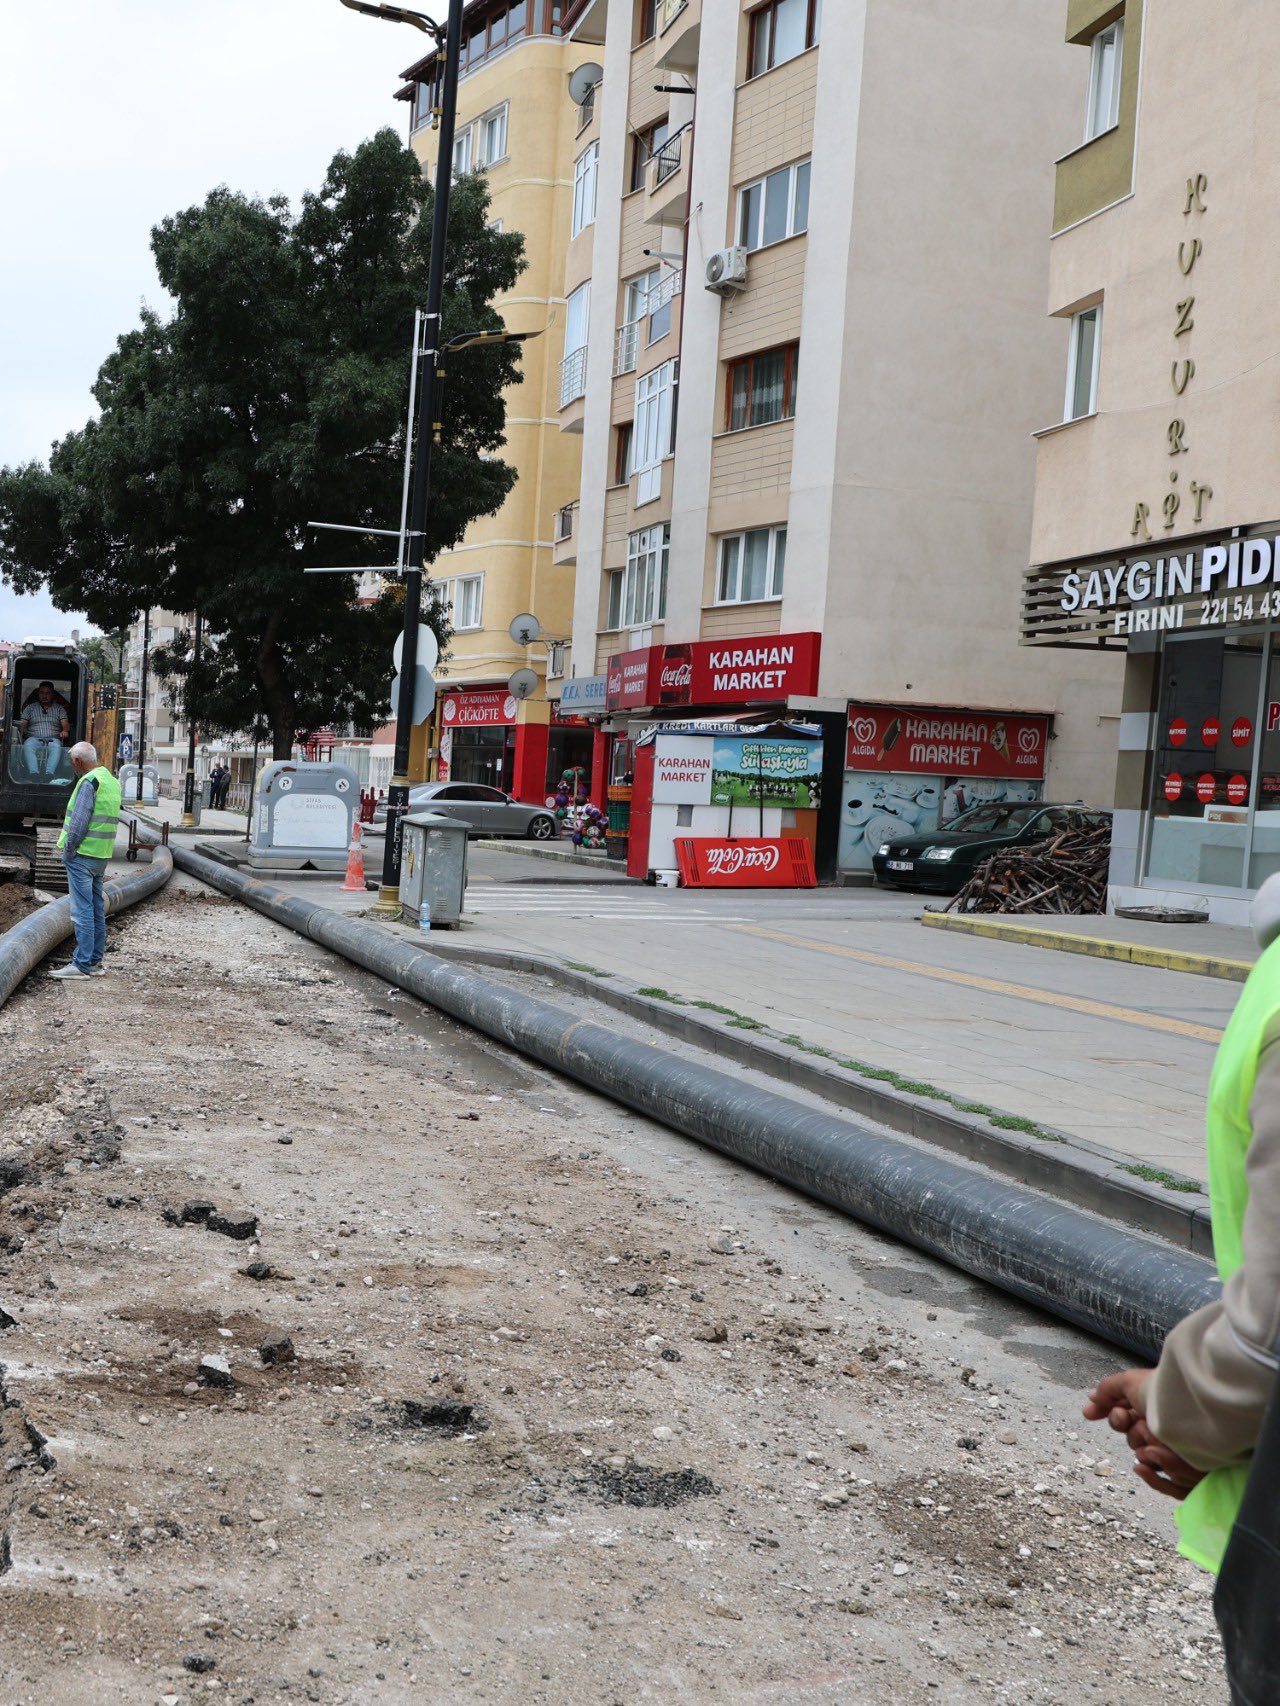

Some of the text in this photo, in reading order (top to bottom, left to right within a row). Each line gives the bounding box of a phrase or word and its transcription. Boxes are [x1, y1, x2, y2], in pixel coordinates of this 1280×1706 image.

[1060, 526, 1280, 611] SAYGIN PİD
[1114, 604, 1184, 635] FIRINI
[1200, 596, 1228, 625] 221
[1233, 593, 1254, 621] 54
[708, 645, 794, 669] KARAHAN
[624, 662, 648, 678] KARAHAN
[713, 669, 787, 691] MARKET
[624, 679, 645, 694] MARKET
[458, 706, 500, 725] ÇİĞKÖFTE
[693, 721, 738, 733] KARTLARI
[905, 718, 989, 743] KARAHAN
[1232, 727, 1251, 738] SİMİT
[658, 757, 711, 769] KARAHAN
[909, 743, 982, 766] MARKET
[660, 772, 707, 783] MARKET
[705, 845, 780, 875] Coca-Cola
